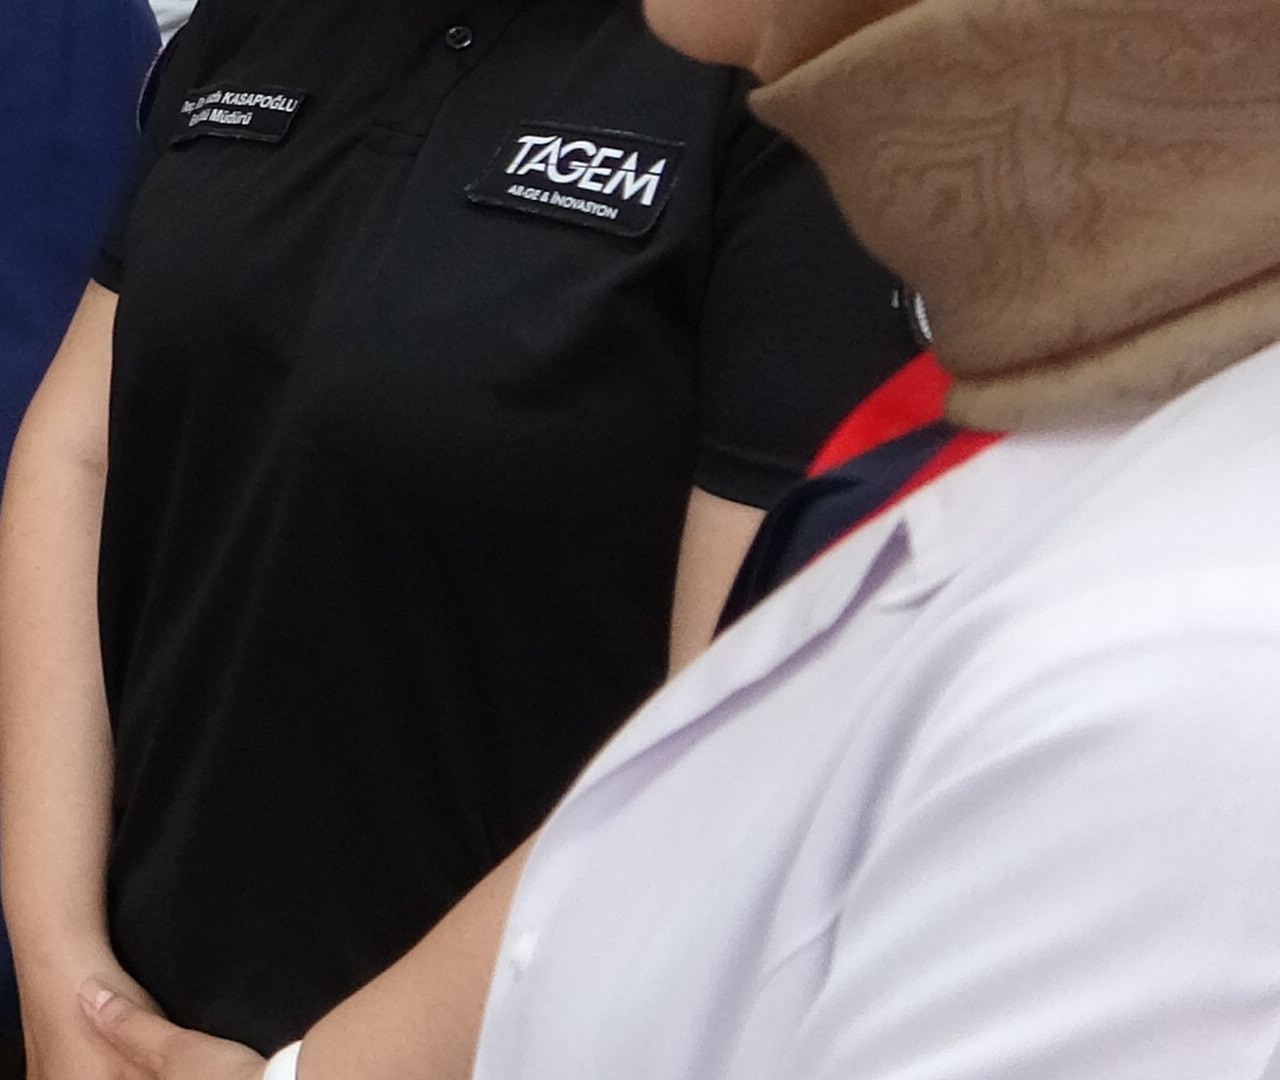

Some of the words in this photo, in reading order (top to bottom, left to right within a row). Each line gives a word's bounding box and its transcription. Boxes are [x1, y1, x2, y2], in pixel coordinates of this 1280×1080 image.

[222, 92, 298, 112] KASAPOĞLU
[210, 109, 252, 125] Müdürü
[505, 135, 667, 206] TAGEM
[508, 185, 541, 201] AR-GE
[550, 191, 618, 219] İNOVASYON
